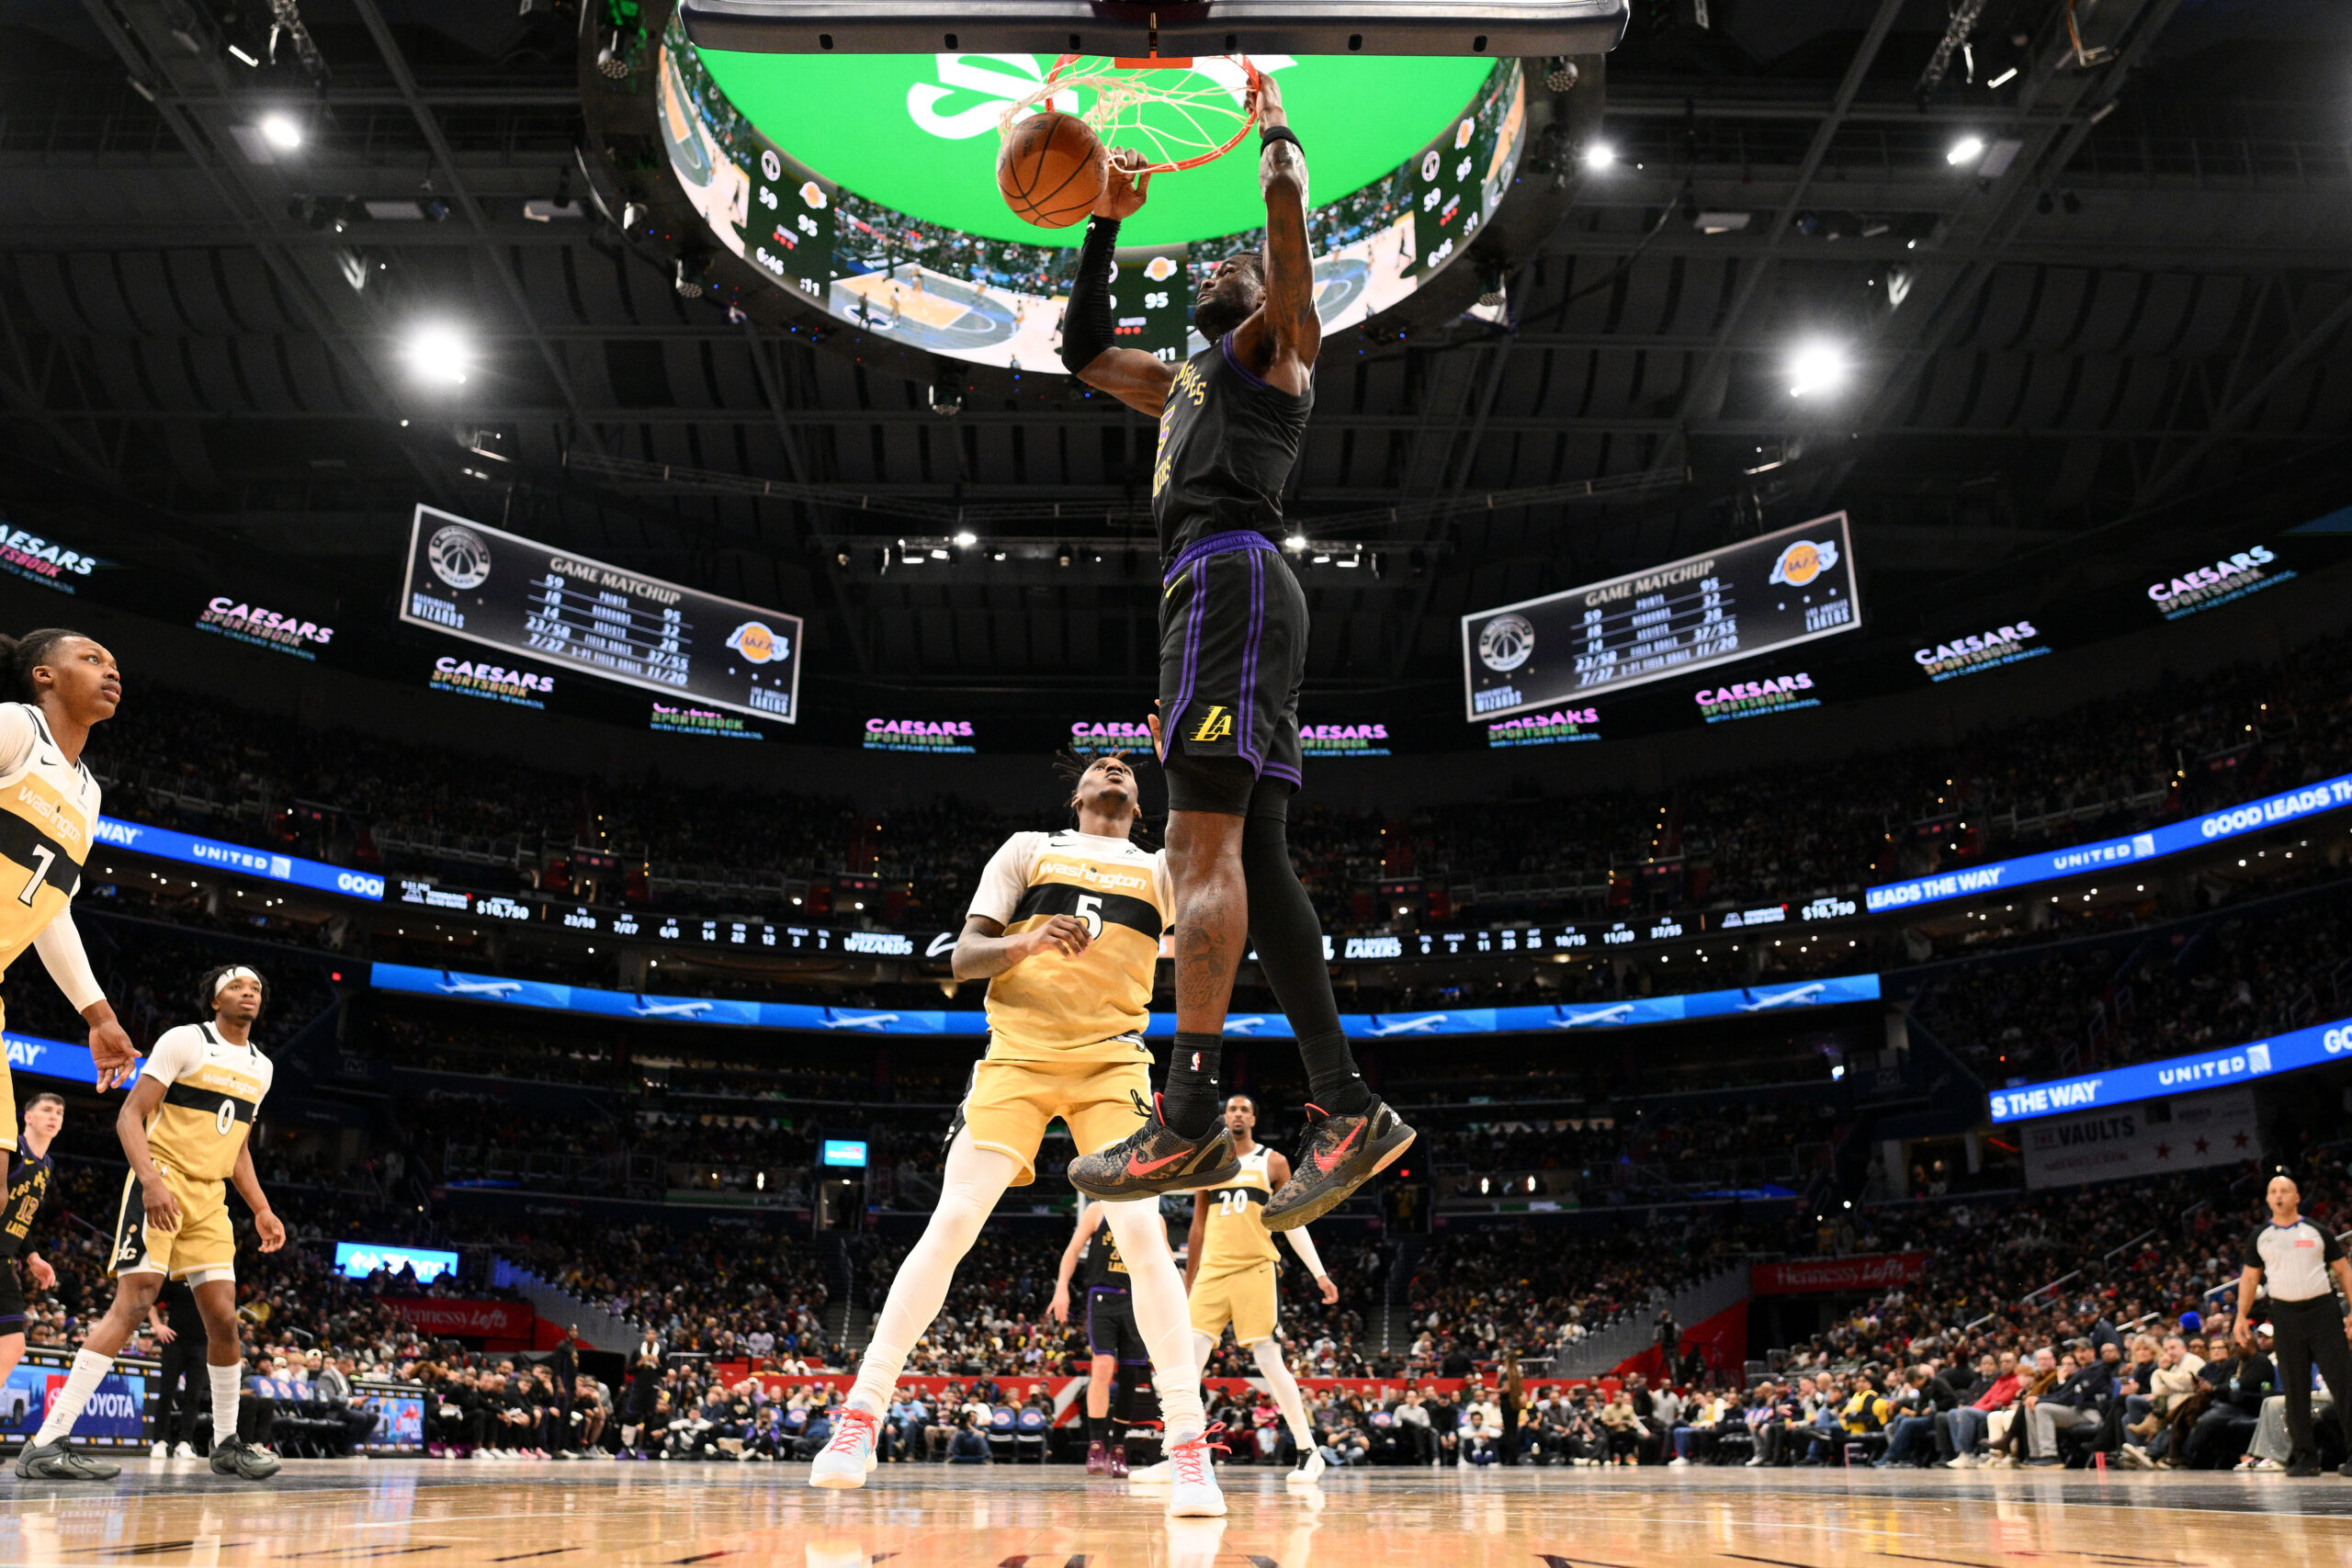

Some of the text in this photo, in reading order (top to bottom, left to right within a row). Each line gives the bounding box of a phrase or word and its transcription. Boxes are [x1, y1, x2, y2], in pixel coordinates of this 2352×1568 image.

[1456, 155, 1472, 182] 95
[759, 186, 777, 210] 59
[1423, 187, 1441, 212] 59
[797, 214, 818, 237] 95
[1145, 291, 1169, 309] 95
[544, 573, 565, 590] 59
[549, 557, 682, 604] GAME MATCHUP
[1586, 559, 1714, 606] GAME MATCHUP
[1700, 577, 1719, 592] 95
[2148, 545, 2274, 601] CAESARS
[545, 590, 562, 605] 18
[1702, 592, 1720, 608] 32
[209, 597, 334, 643] CAESARS
[543, 605, 560, 620] 14
[663, 608, 682, 624] 95
[1584, 609, 1602, 625] 59
[662, 623, 680, 638] 32
[1694, 619, 1736, 642] 37/55
[528, 633, 565, 653] 7/27
[1588, 638, 1603, 654] 14
[1697, 635, 1738, 657] 11/20
[1915, 621, 2038, 665] CAESARS
[647, 649, 689, 671] 37/55
[432, 670, 529, 698] SPORTSBOOK
[435, 657, 554, 693] CAESARS
[647, 665, 688, 685] 11/20
[1695, 672, 1814, 705] CAESARS
[1701, 691, 1795, 716] SPORTSBOOK
[865, 718, 973, 737] CAESARS
[17, 785, 81, 846] washington
[2202, 807, 2262, 840] GOOD
[2265, 791, 2330, 822] LEADS
[193, 843, 267, 871] UNITED
[2053, 843, 2131, 871] UNITED
[17, 843, 56, 908] 7
[1040, 861, 1148, 891] washington
[1921, 877, 1960, 898] THE
[476, 899, 530, 919] $10,750
[1074, 894, 1103, 942] 5
[1802, 901, 1857, 921] $10,750
[614, 920, 639, 935] 7/27
[702, 930, 716, 941] 14
[730, 931, 745, 943] 22
[763, 934, 775, 945] 12
[793, 937, 800, 947] 3
[819, 938, 827, 949] 3
[843, 937, 913, 955] WIZARDS
[1450, 942, 1458, 953] 2
[1477, 941, 1490, 952] 11
[2159, 1055, 2245, 1086] UNITED
[2007, 1089, 2048, 1113] THE
[216, 1099, 235, 1135] 0
[2059, 1116, 2135, 1146] VAULTS
[16, 1195, 39, 1225] 12
[1218, 1189, 1248, 1217] 20
[1777, 1258, 1904, 1286] Hennessy Lofts
[470, 1308, 508, 1330] Lofts
[81, 1393, 135, 1418] OYOTA
